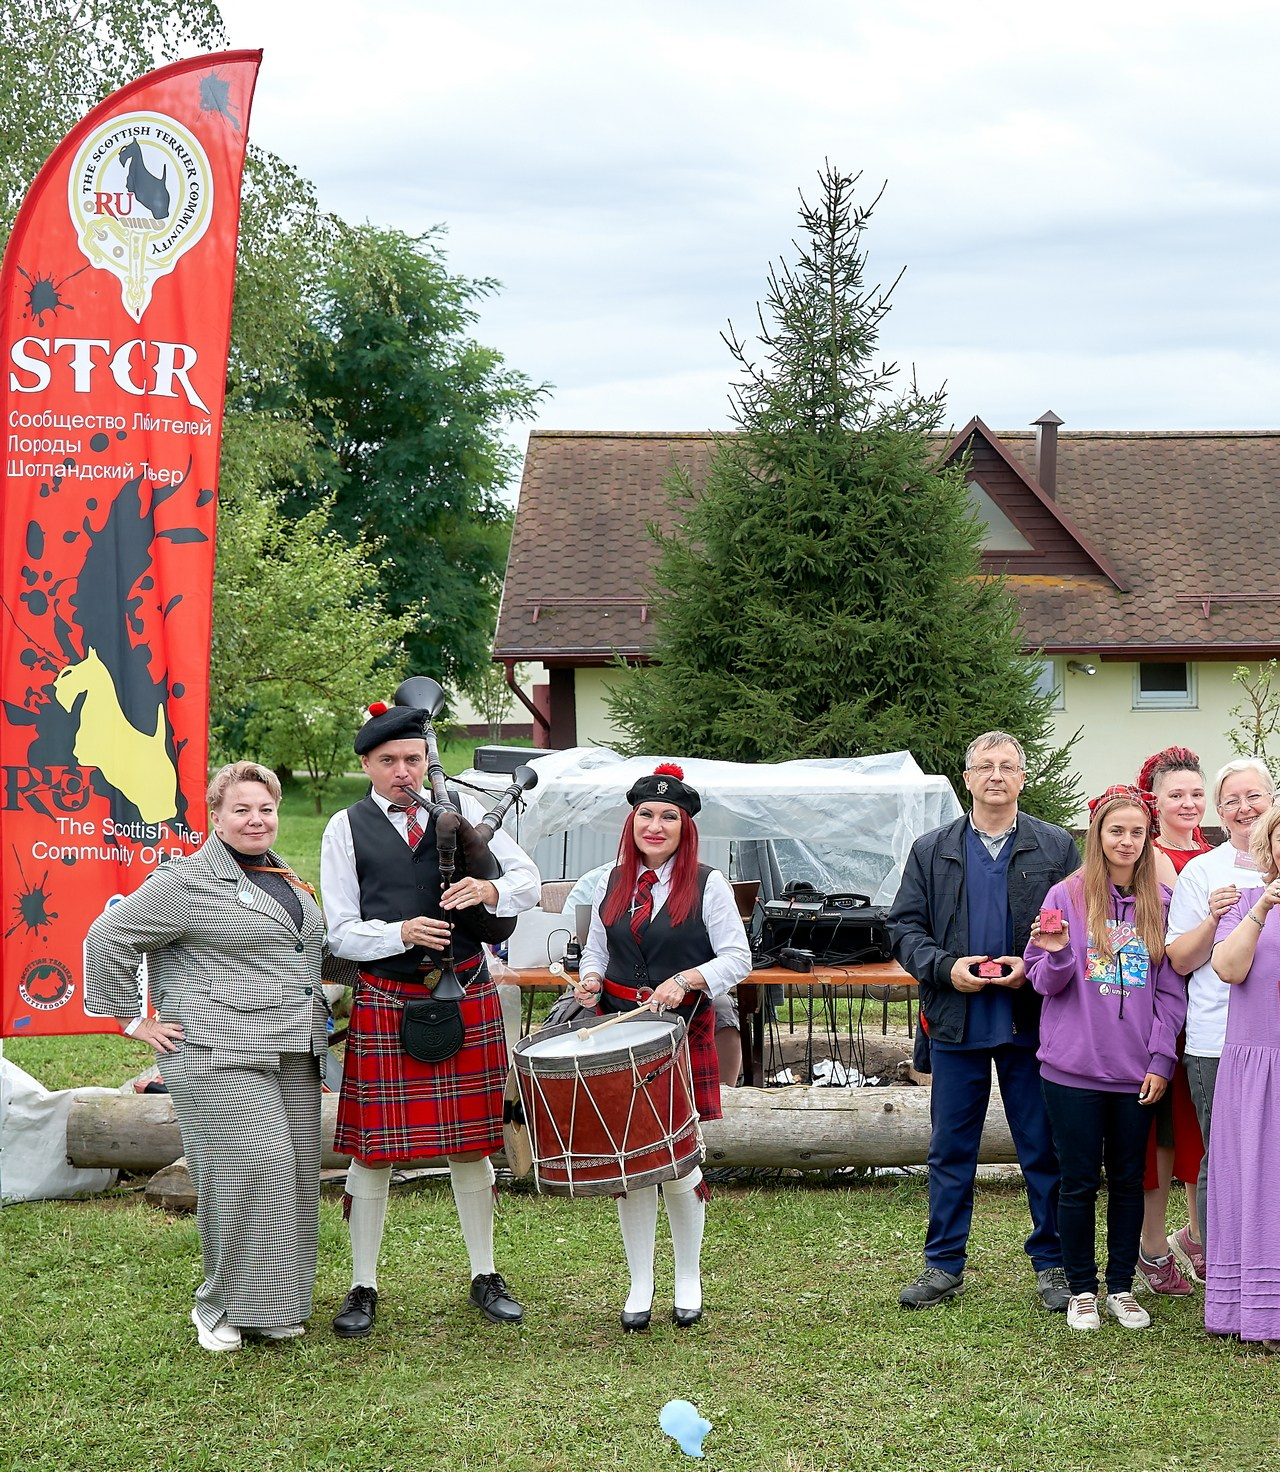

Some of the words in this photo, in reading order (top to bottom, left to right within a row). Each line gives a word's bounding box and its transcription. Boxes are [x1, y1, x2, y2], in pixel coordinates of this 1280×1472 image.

[93, 127, 150, 162] SCOTTISH
[156, 129, 197, 179] TERRIER
[83, 164, 96, 194] THE
[94, 192, 133, 221] RU
[152, 181, 199, 254] COMMUNITY
[9, 336, 211, 415] STCR
[9, 410, 126, 430] Сообщество
[8, 434, 81, 456] Породы
[7, 459, 134, 481] Шотландский
[56, 817, 95, 835] The
[102, 818, 169, 840] Scottish
[32, 841, 134, 867] Community
[140, 846, 164, 864] Of
